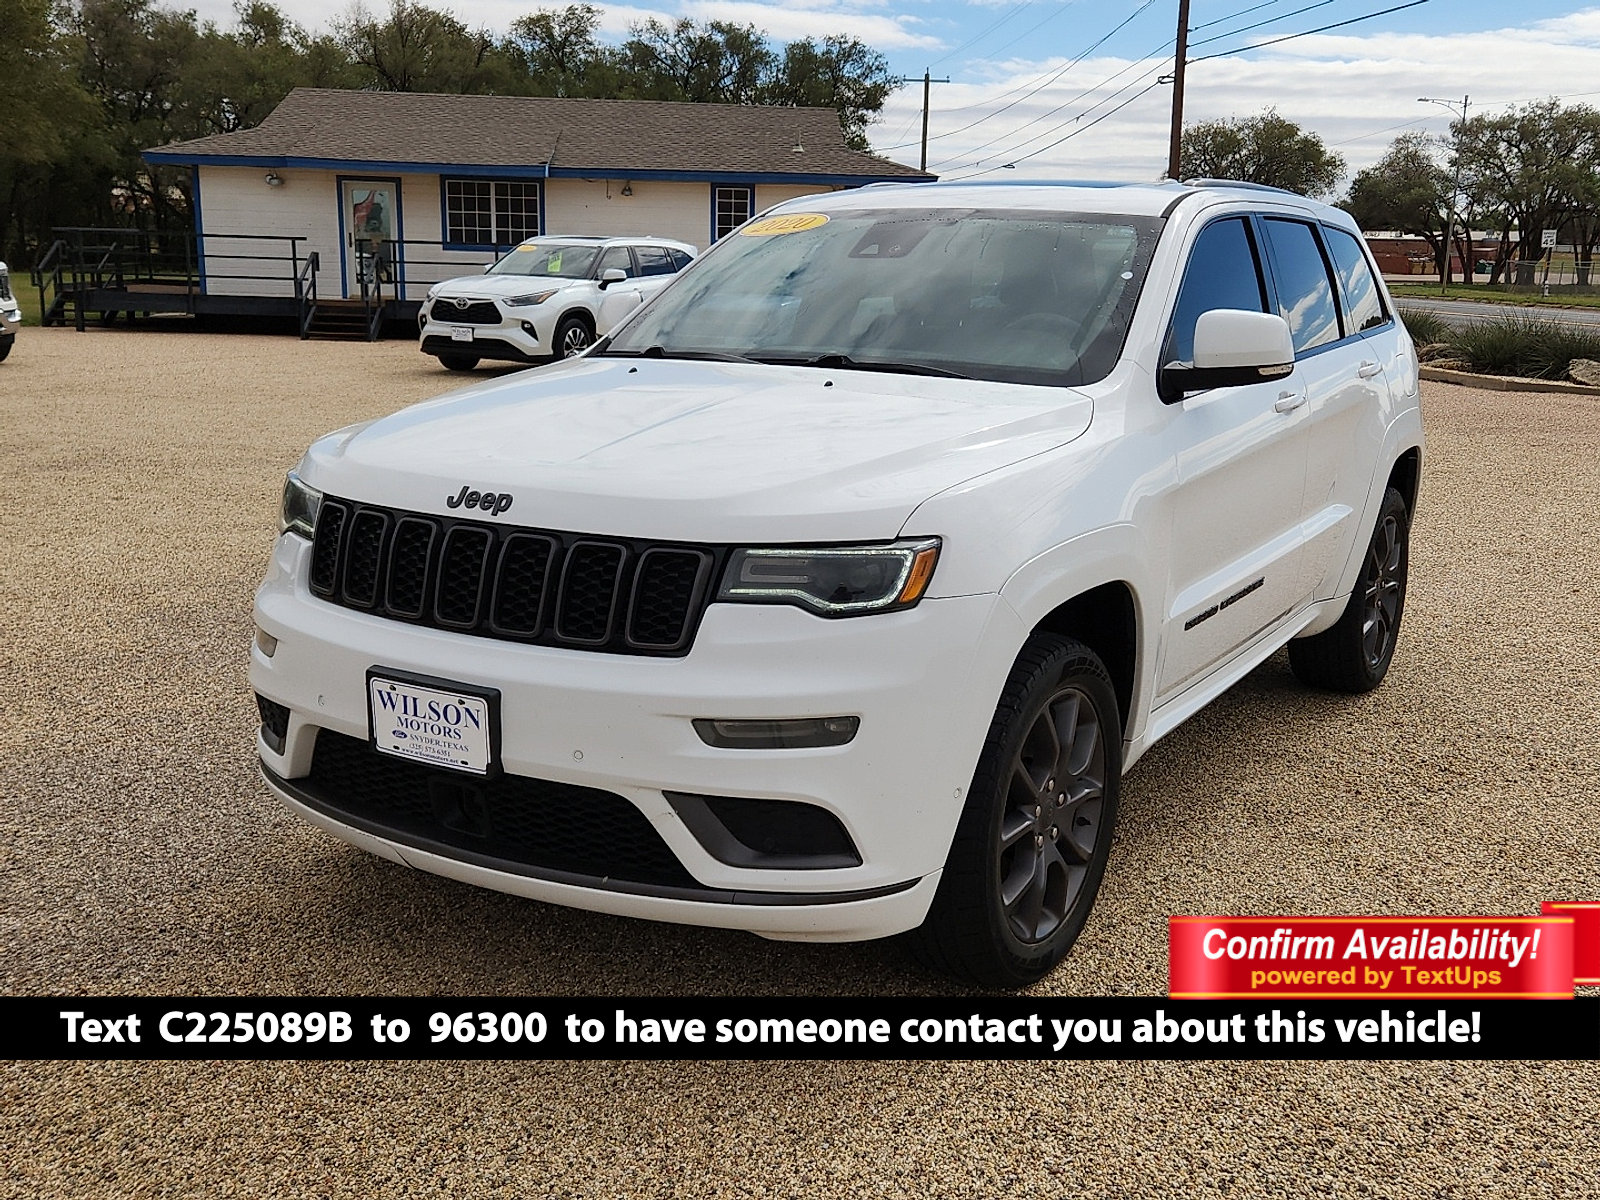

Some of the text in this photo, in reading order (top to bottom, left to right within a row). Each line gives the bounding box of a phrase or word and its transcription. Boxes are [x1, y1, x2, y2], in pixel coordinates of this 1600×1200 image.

[751, 216, 818, 233] 2020
[1542, 238, 1555, 246] 45
[446, 485, 514, 517] Jeep
[377, 689, 480, 730] WILSON
[397, 716, 462, 739] MOTORS
